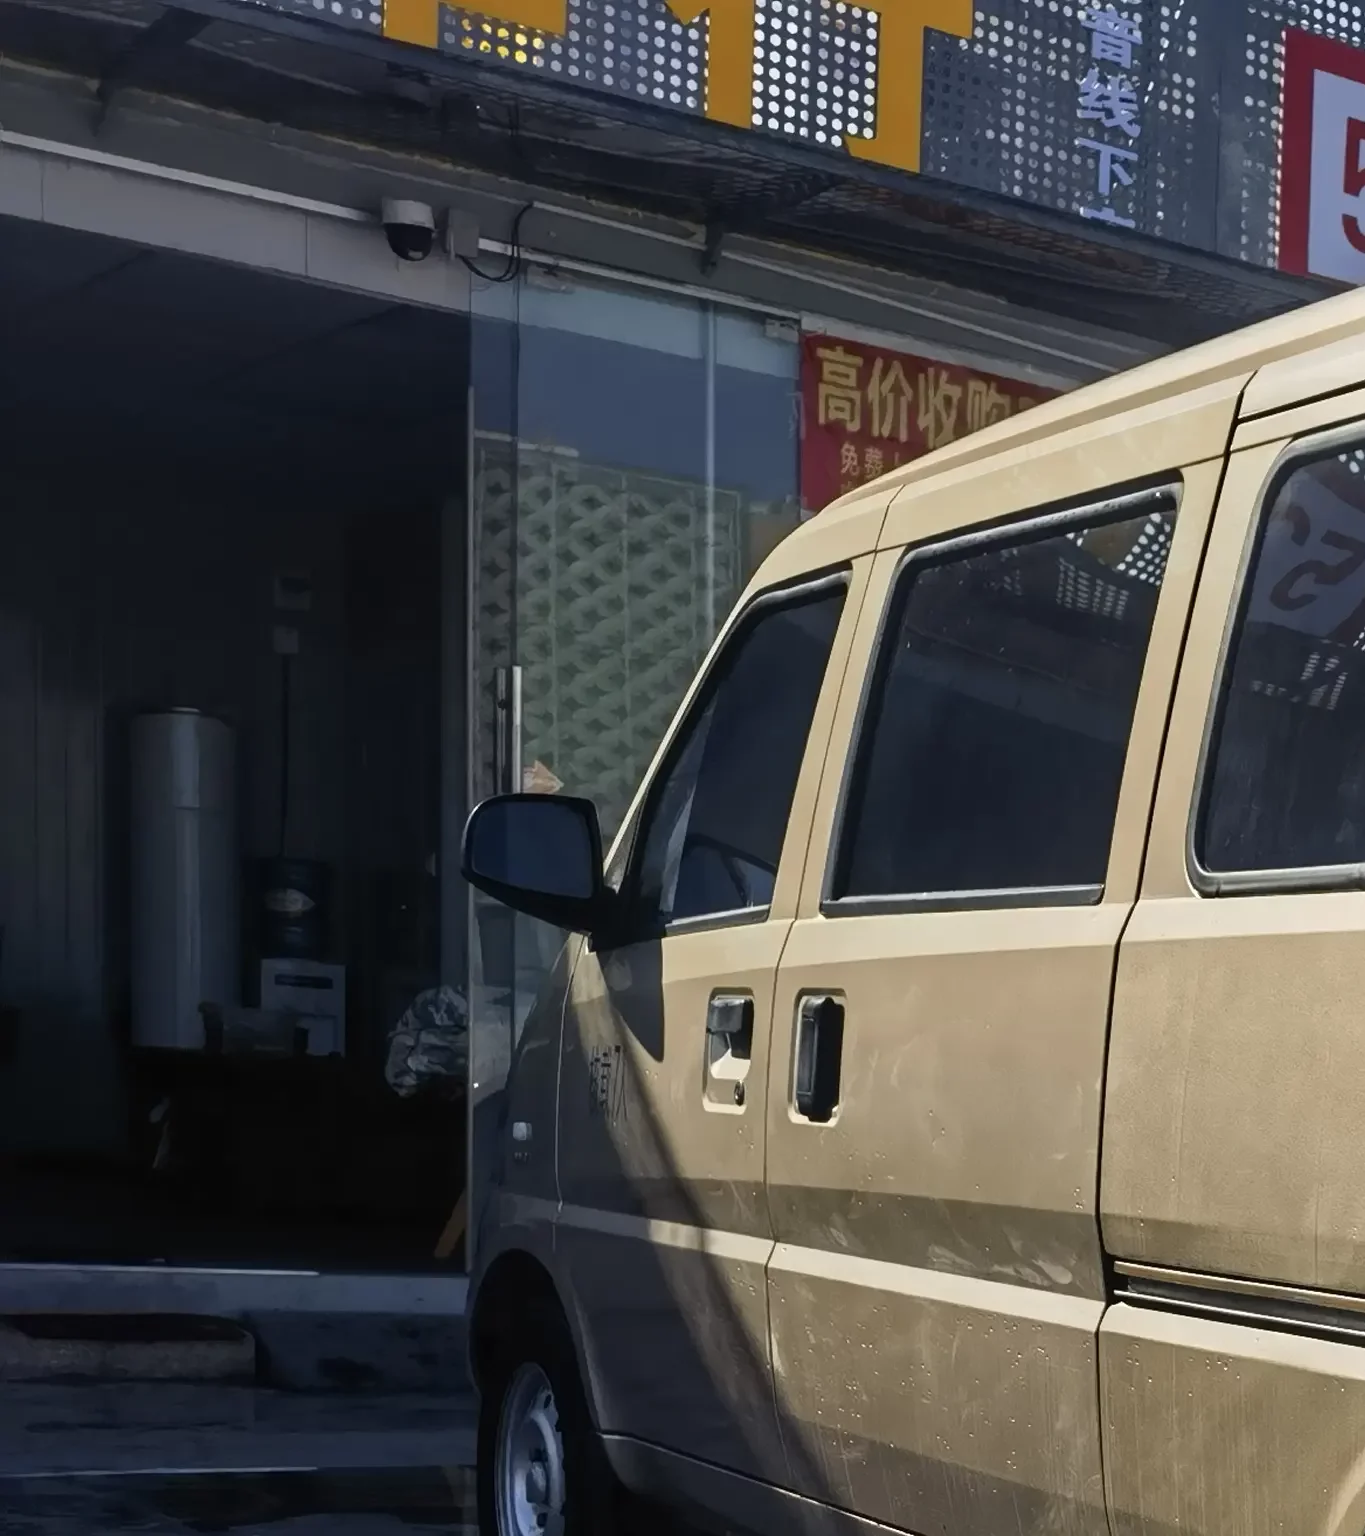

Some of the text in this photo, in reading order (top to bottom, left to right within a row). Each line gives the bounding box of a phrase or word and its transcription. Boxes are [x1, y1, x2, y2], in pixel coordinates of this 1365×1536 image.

[1074, 6, 1143, 229] 音线下
[816, 346, 1038, 450] 高价收购
[839, 442, 902, 478] 免费
